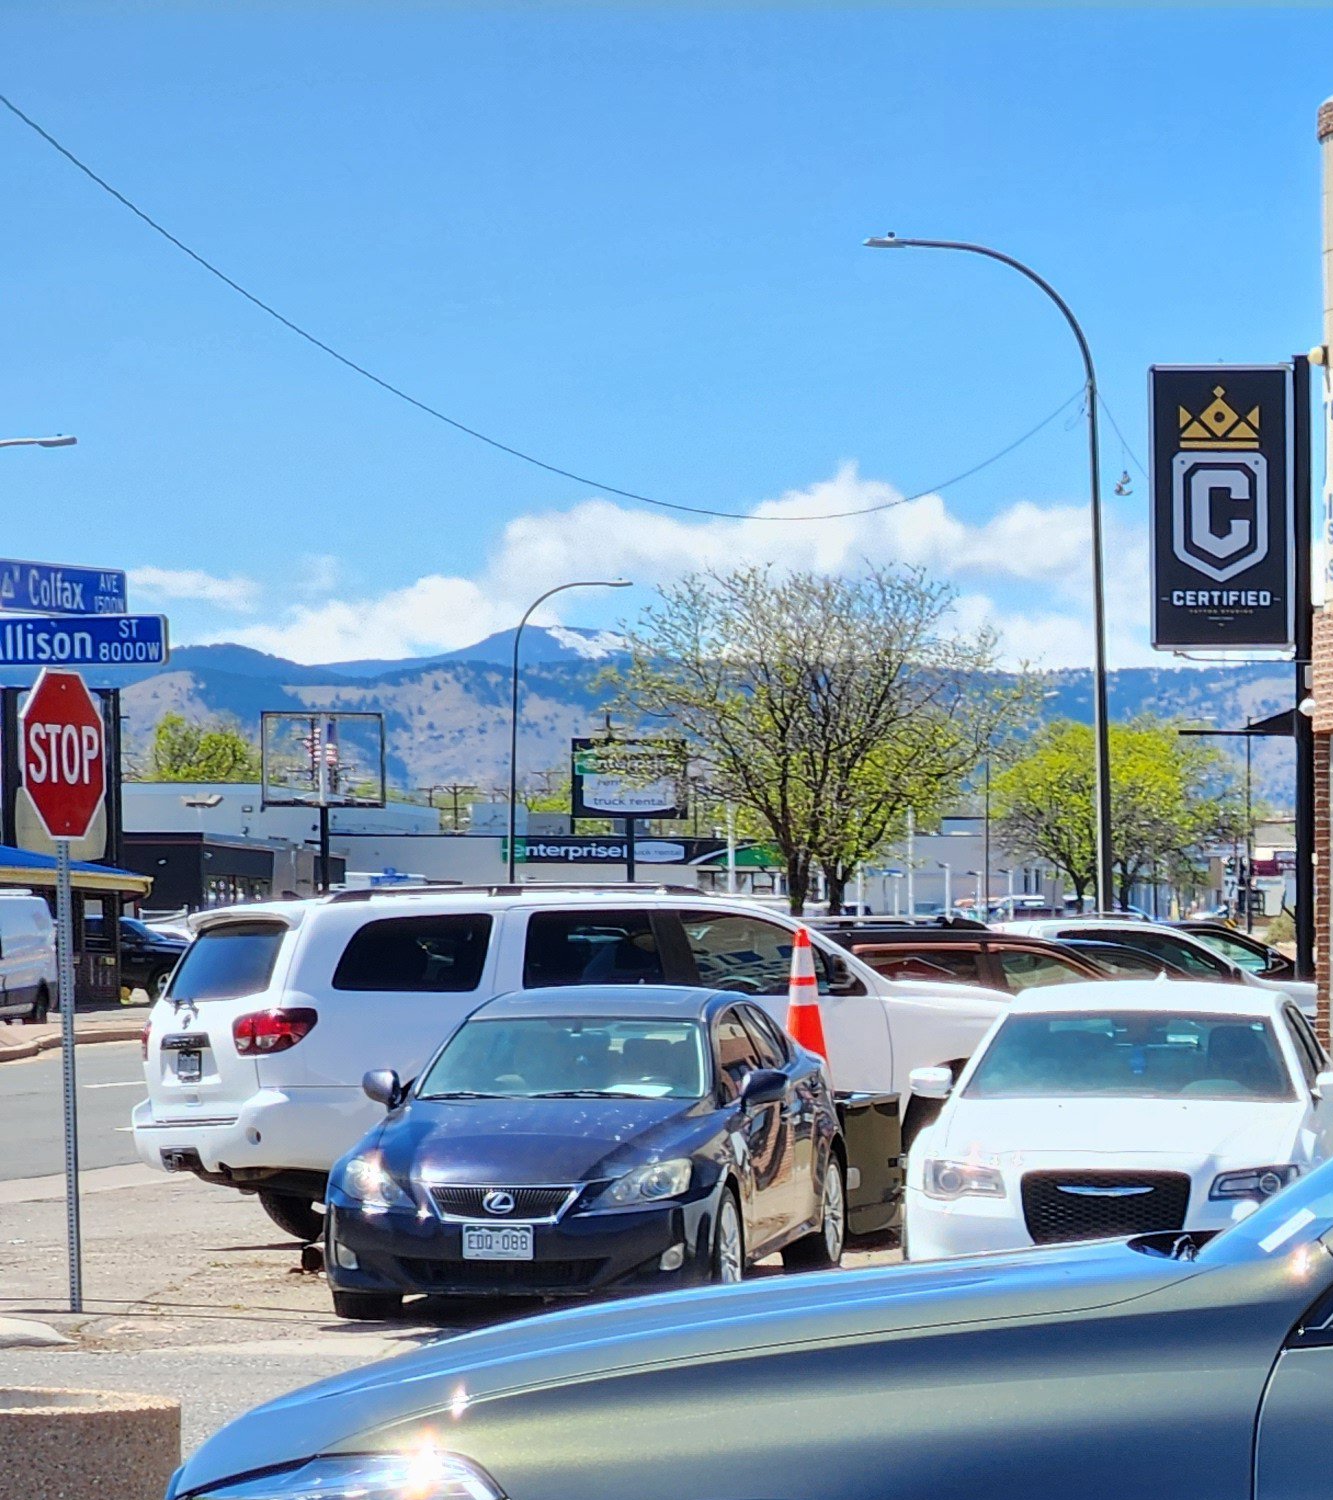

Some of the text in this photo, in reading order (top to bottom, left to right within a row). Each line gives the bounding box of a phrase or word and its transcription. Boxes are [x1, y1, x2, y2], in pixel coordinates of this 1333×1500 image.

[29, 568, 86, 611] Colfax
[98, 573, 120, 594] AVE
[1172, 591, 1271, 606] CERTIFIED
[0, 619, 139, 661] llison ST
[99, 642, 160, 661] 8000W
[29, 722, 99, 785] STOP
[593, 797, 626, 806] truck
[514, 842, 622, 860] enterprise
